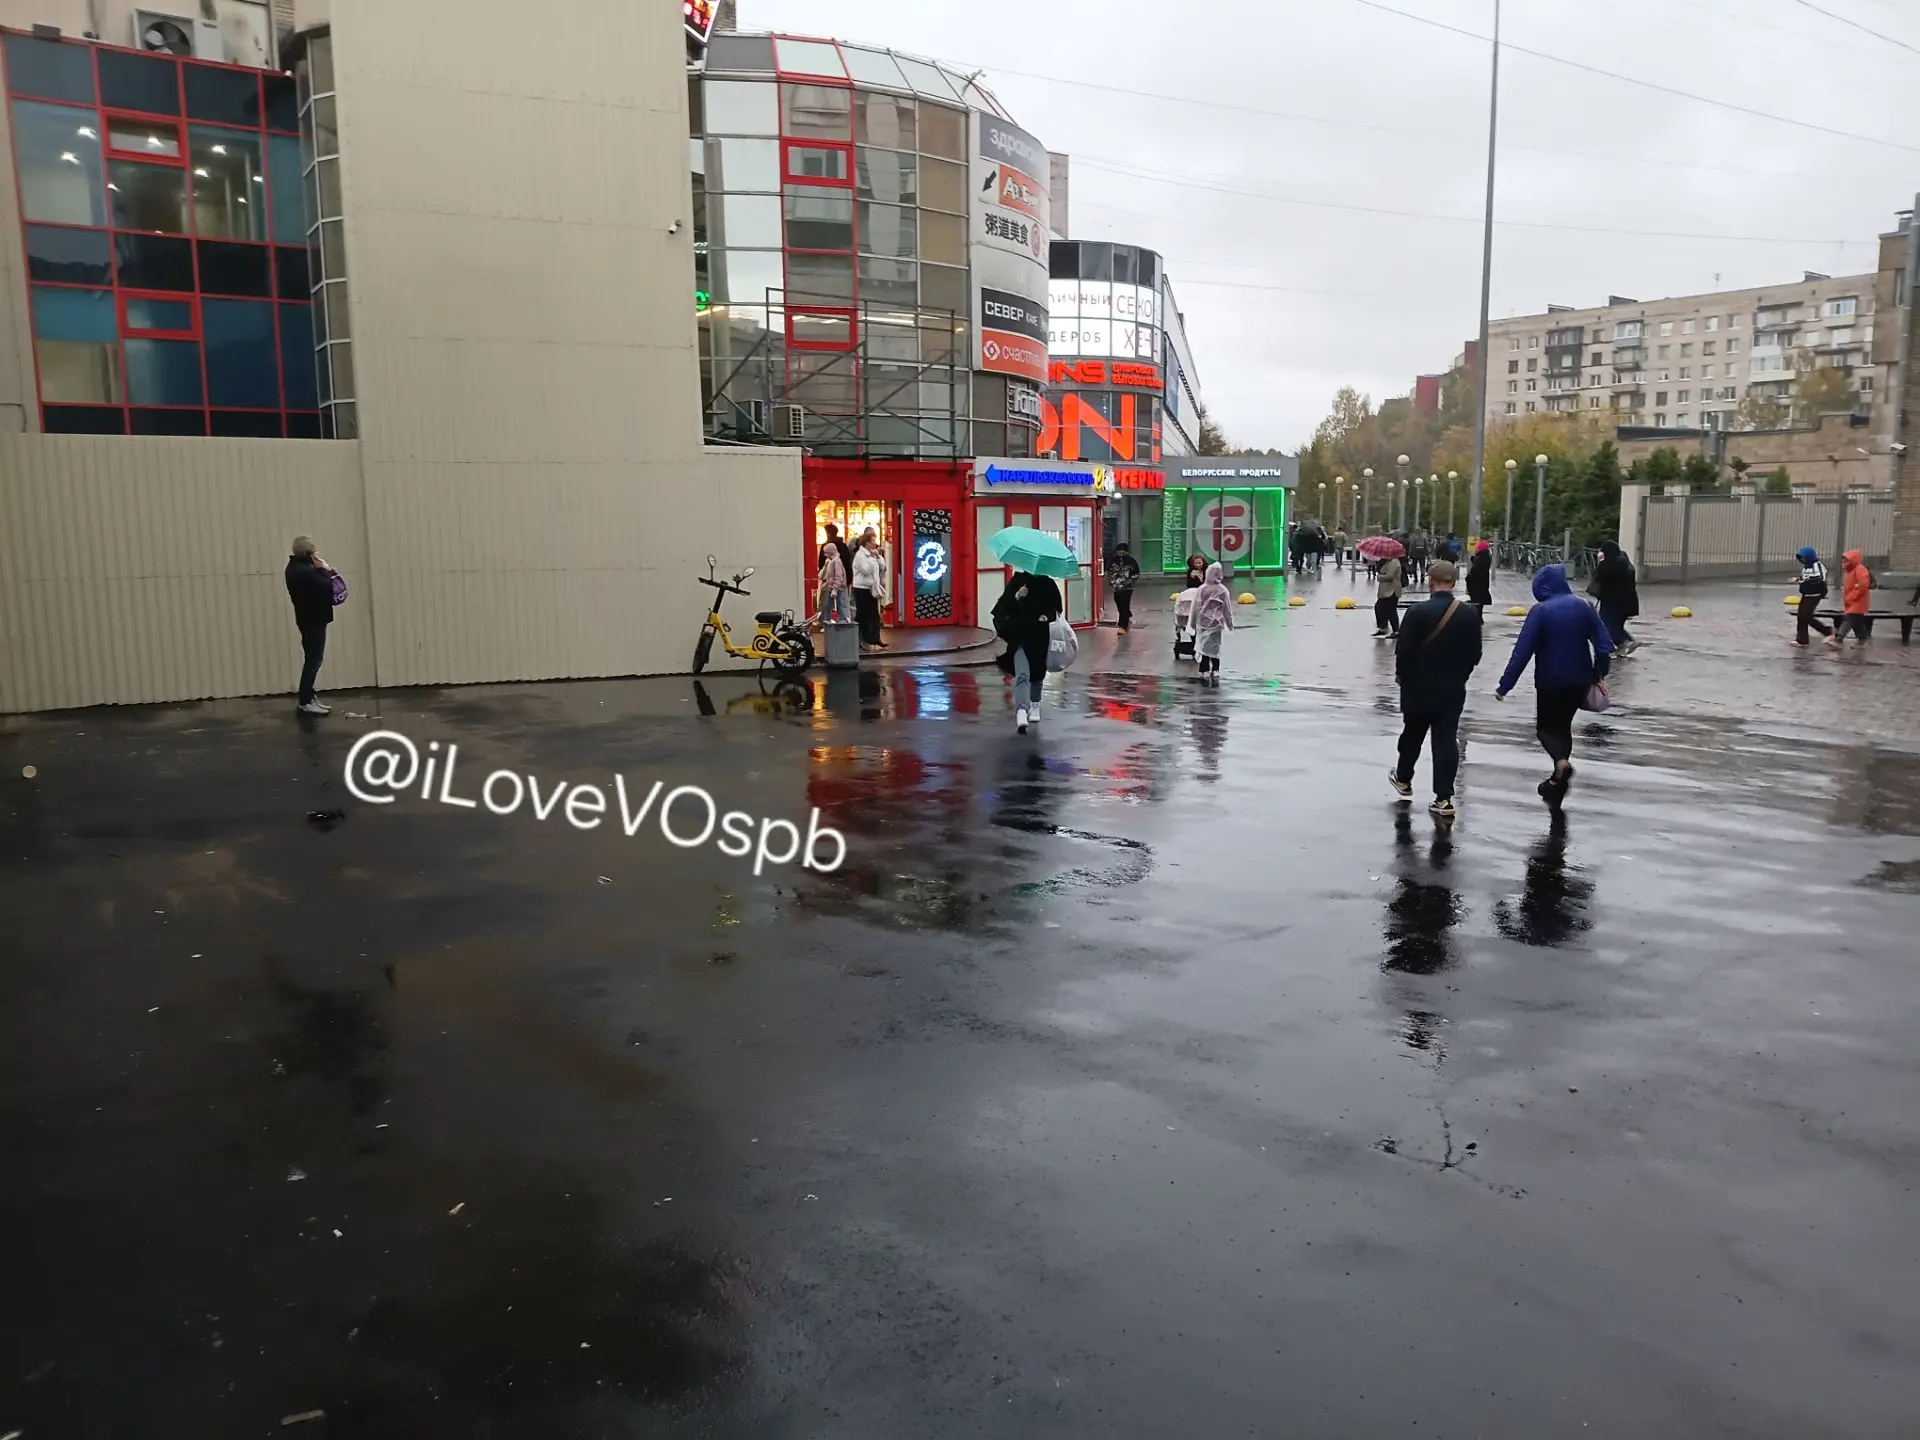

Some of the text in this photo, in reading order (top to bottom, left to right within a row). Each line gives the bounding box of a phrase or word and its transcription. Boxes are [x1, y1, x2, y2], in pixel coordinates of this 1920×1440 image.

[985, 300, 1024, 321] СЕВЕР
[1047, 331, 1101, 343] ДЕРОБ
[1182, 468, 1281, 477] БЕЛОРУССКИЕ ПРОДУКТЫ
